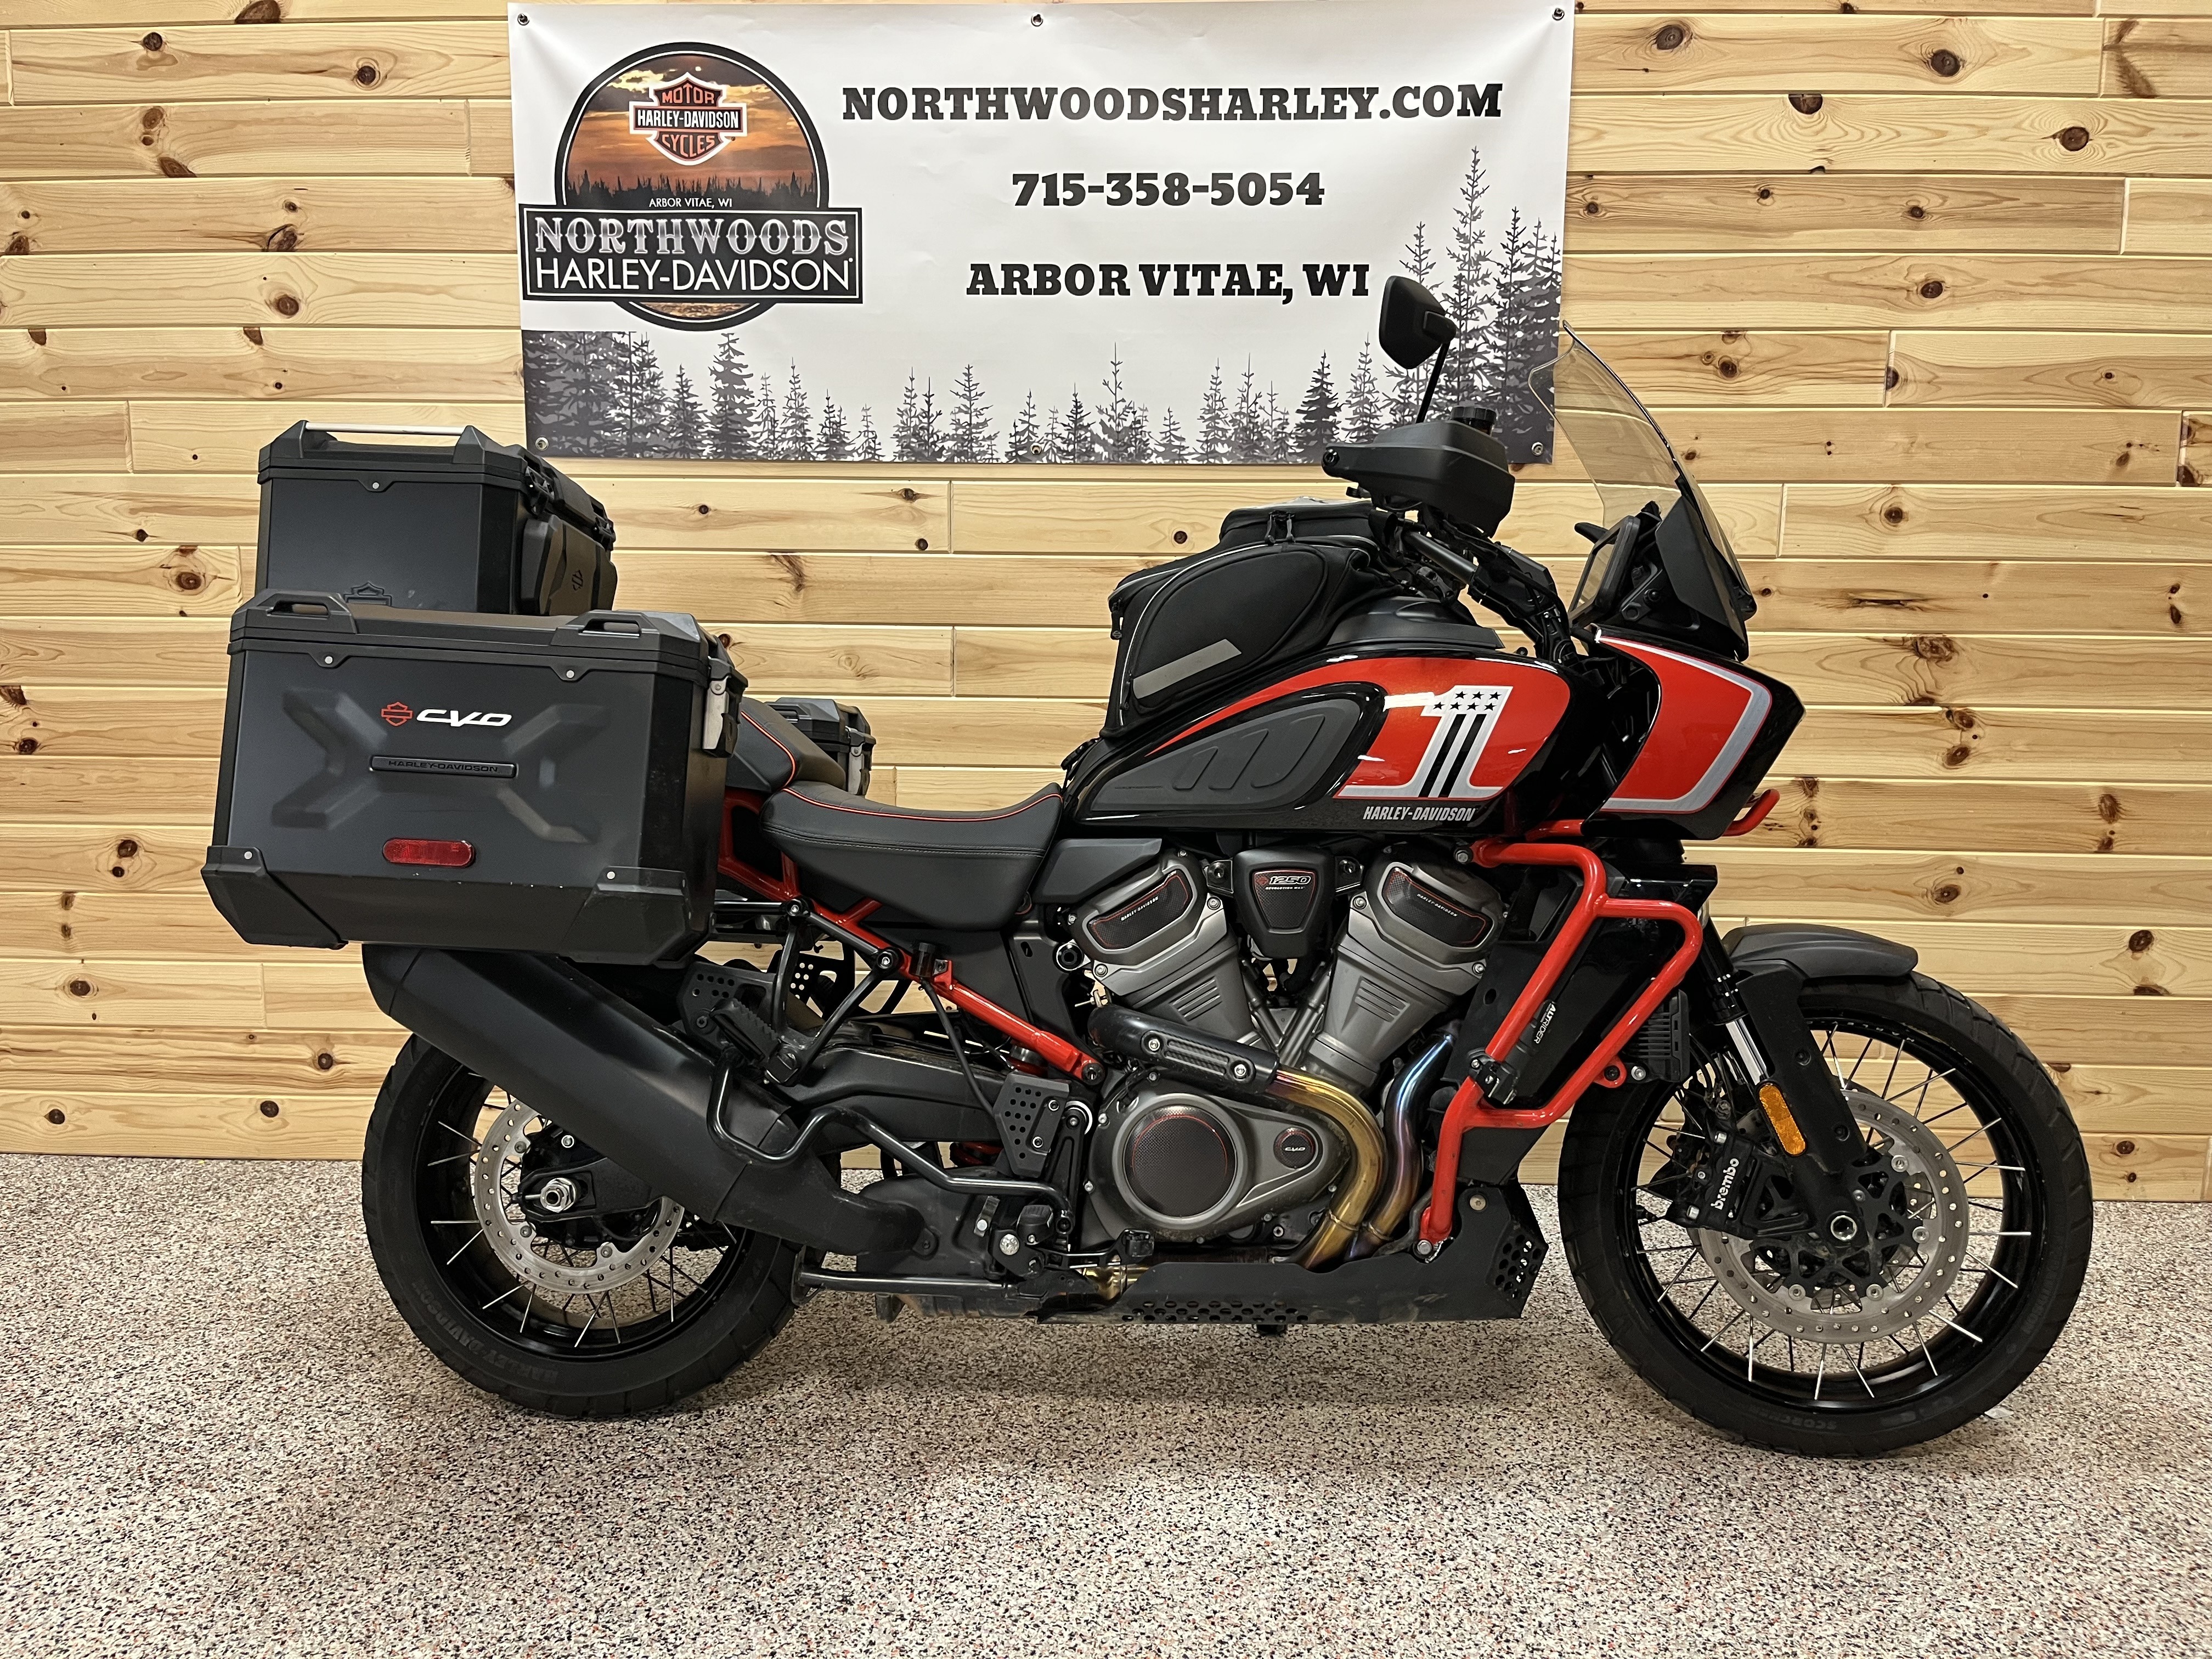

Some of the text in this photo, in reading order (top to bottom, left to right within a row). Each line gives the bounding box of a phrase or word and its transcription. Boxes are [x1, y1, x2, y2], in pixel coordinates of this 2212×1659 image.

[662, 82, 715, 104] MOTOR
[843, 83, 1503, 121] NORTHWOODSHARLEY.COM
[637, 109, 739, 128] HARLEY-DAVIDSON
[662, 134, 715, 157] CYCLES
[1012, 172, 1325, 206] 715-358-5054
[648, 198, 732, 209] ARBOR VITAE, WI
[534, 216, 849, 256] NORTHWOODS
[535, 257, 850, 291] HARLEY-DAVIDSON
[966, 263, 1369, 305] ARBOR VITAE, WI
[416, 709, 512, 727] CVO
[388, 760, 498, 772] HARLEY-DAVIDSON
[1363, 806, 1476, 821] HARLEY-DAVIDSON
[1269, 876, 1311, 885] 1250
[1534, 1004, 1556, 1044] ALTRIDER
[1711, 1158, 1739, 1210] brembo
